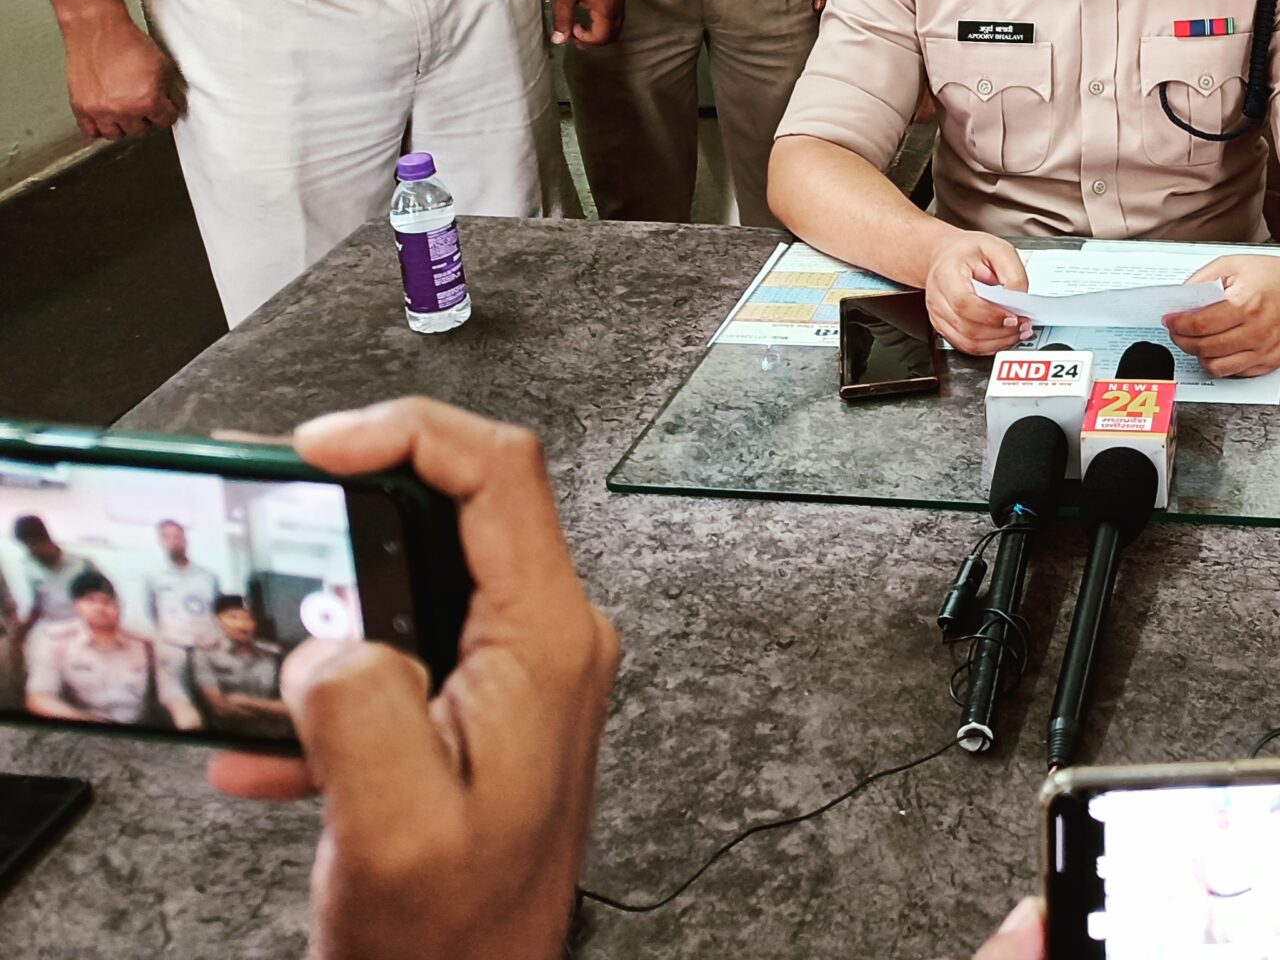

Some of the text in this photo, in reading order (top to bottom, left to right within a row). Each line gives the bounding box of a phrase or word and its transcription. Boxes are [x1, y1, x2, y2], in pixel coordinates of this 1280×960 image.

[999, 362, 1078, 379] IND 24
[1108, 383, 1159, 391] NEWS
[1099, 390, 1160, 417] 24
